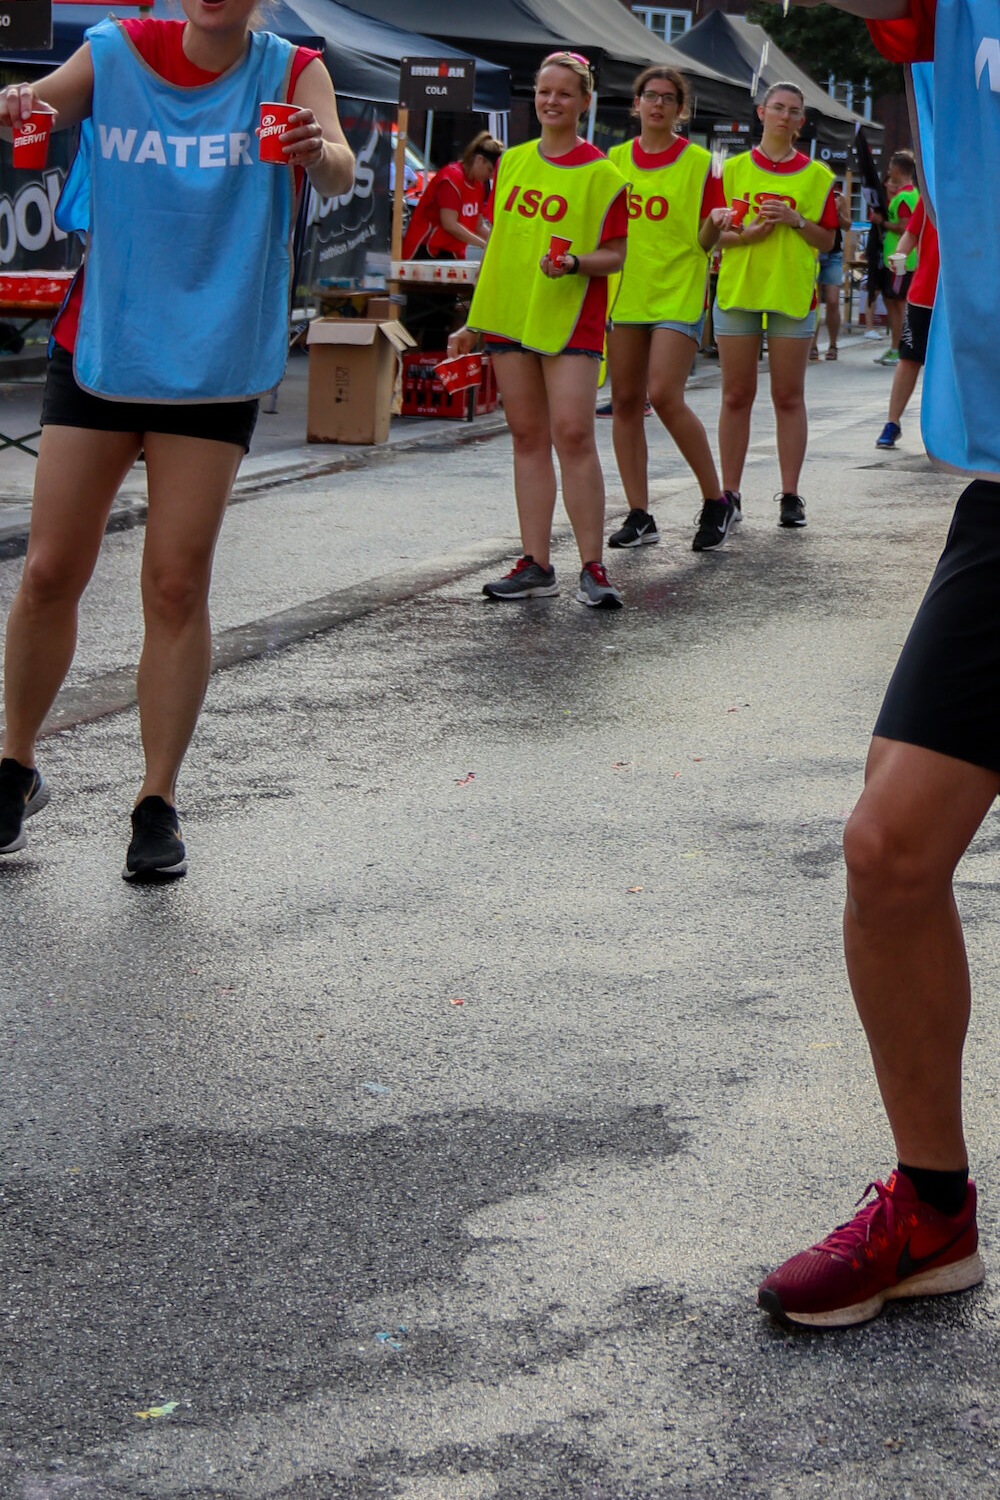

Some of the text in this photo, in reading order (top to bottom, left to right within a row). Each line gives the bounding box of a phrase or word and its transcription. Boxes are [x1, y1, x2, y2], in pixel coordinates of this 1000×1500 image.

[411, 62, 465, 77] IRONMAN
[425, 86, 447, 95] COLA
[99, 124, 253, 168] WATER
[504, 185, 568, 222] ISO
[628, 194, 669, 221] SO
